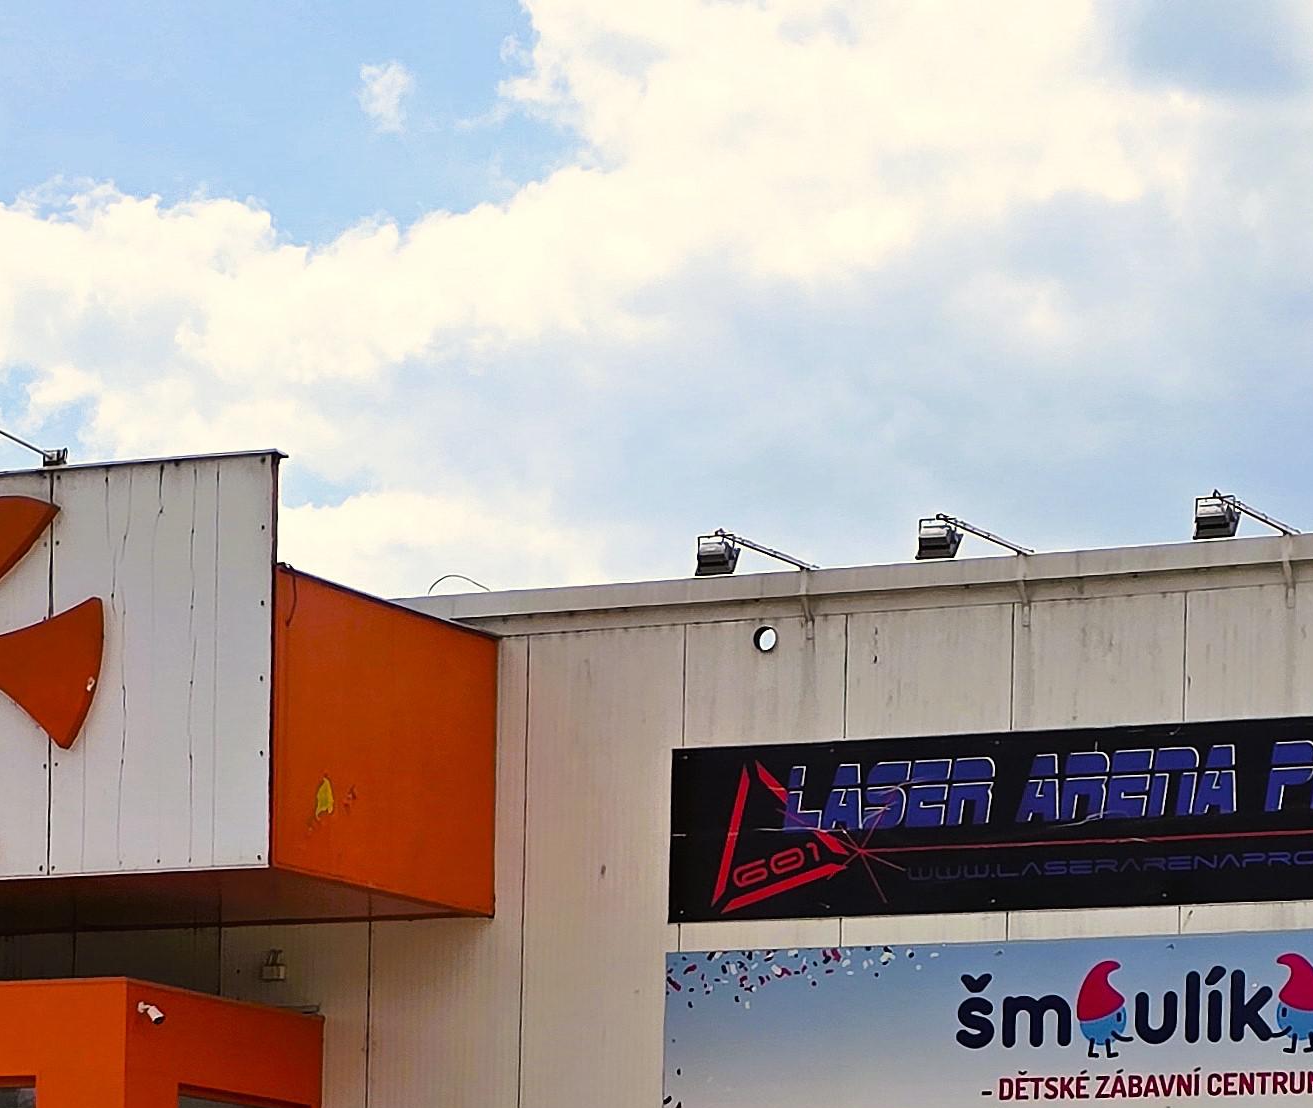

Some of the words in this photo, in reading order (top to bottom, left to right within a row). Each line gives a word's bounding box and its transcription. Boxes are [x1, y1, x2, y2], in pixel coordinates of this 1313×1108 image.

[783, 757, 995, 832] LASER
[1015, 744, 1237, 825] ARENA
[999, 1069, 1087, 1101] DĚTSKÉ
[1095, 1067, 1201, 1099] ZÁBAVNÍ
